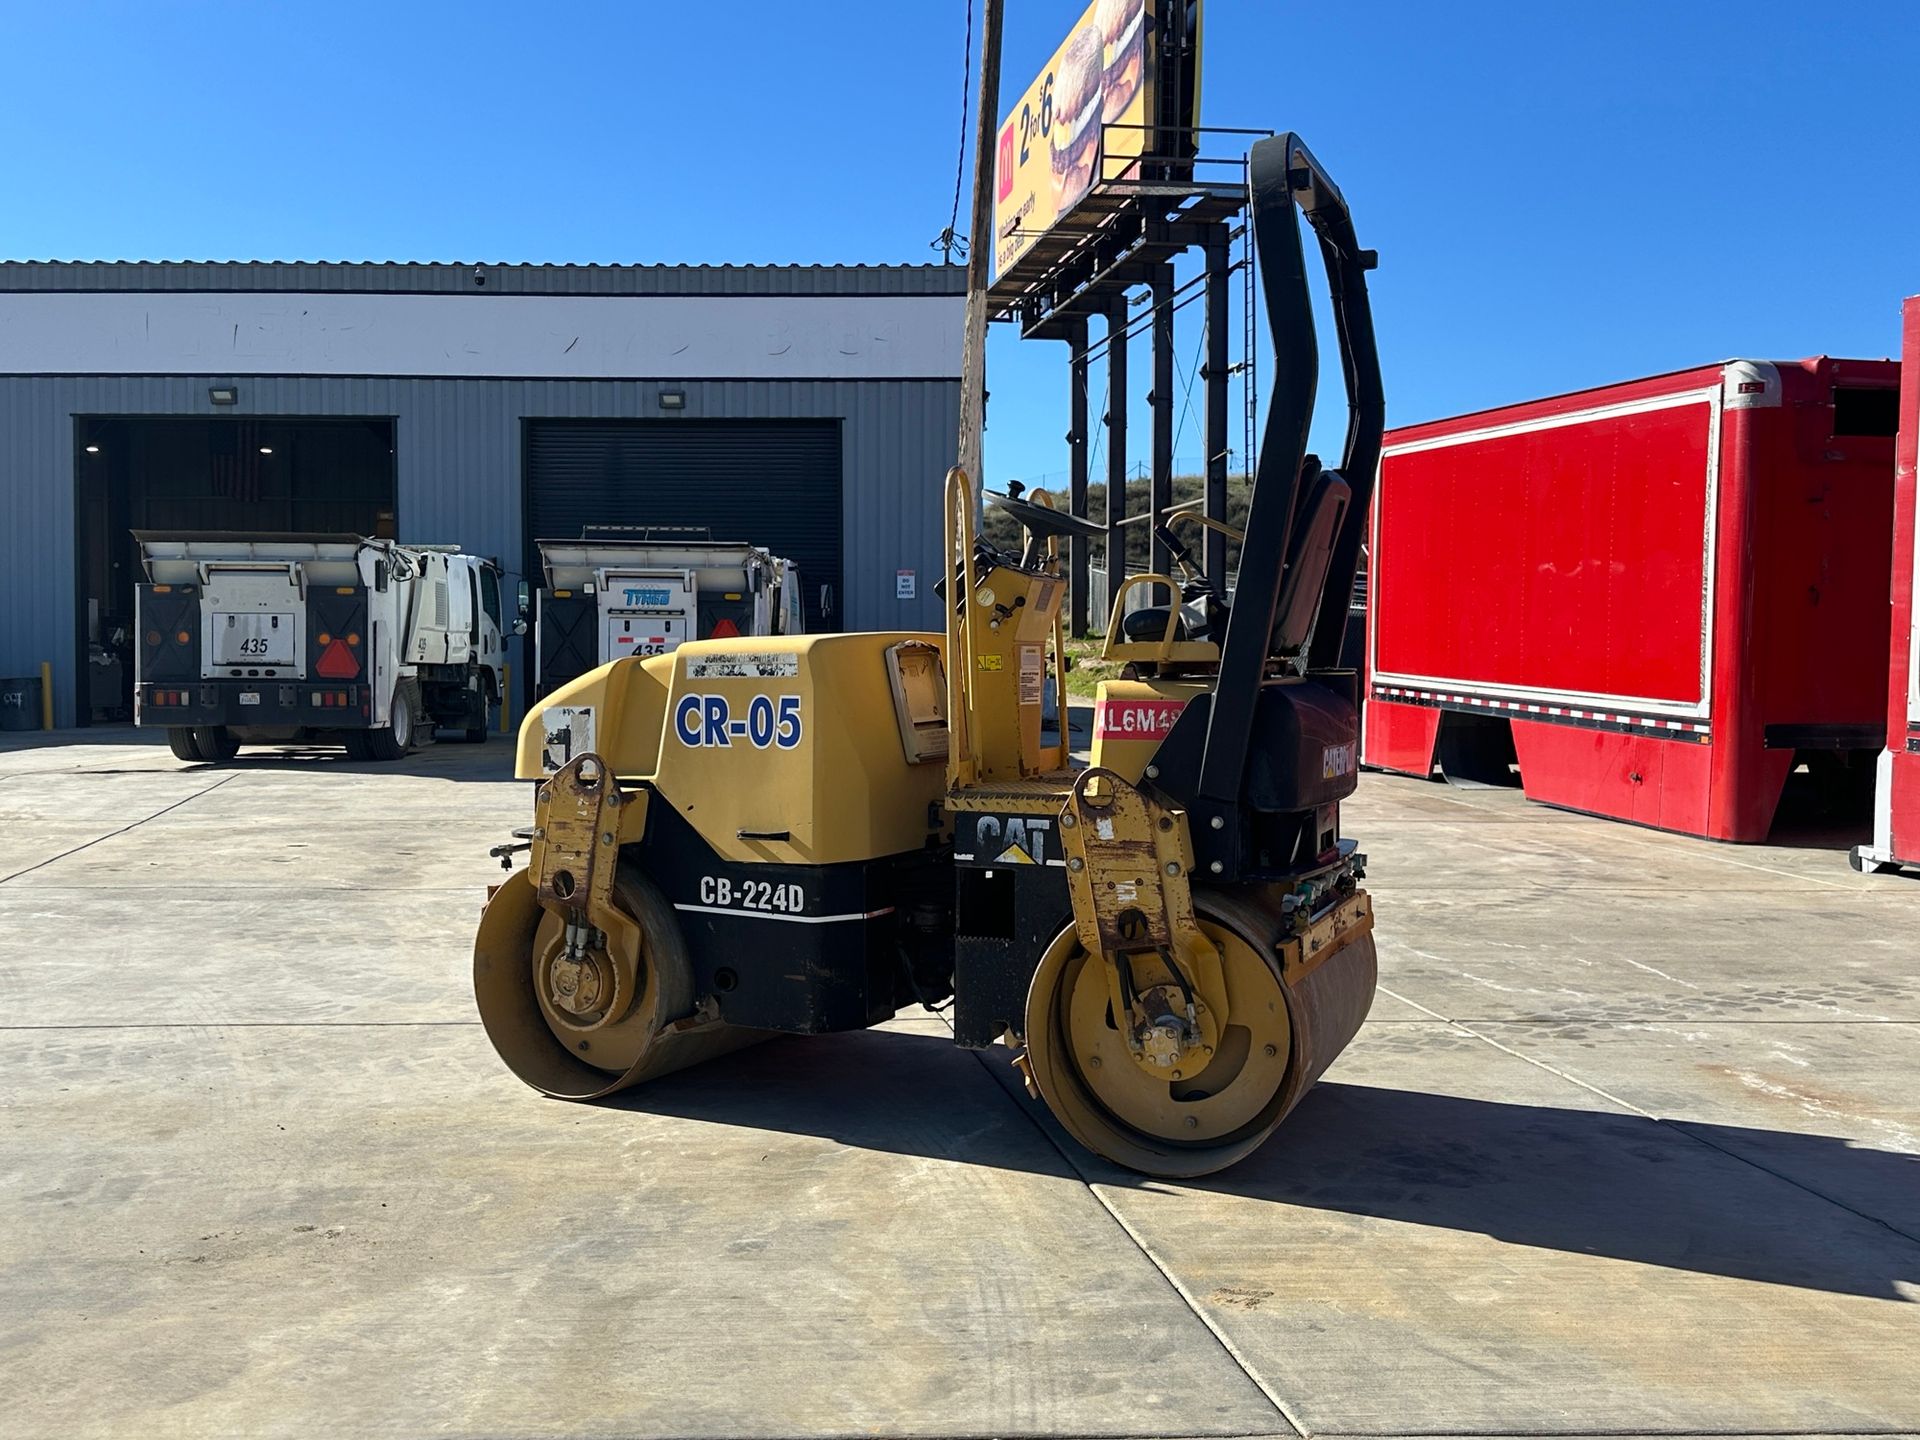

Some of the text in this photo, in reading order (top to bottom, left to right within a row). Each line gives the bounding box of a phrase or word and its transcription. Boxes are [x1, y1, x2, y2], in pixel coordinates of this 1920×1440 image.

[1020, 103, 1030, 168] 2
[1030, 114, 1040, 141] for
[240, 638, 268, 654] 435
[632, 645, 665, 656] 435
[675, 693, 803, 750] CR-05
[976, 815, 1050, 866] CAT
[700, 876, 804, 913] CB-224D
